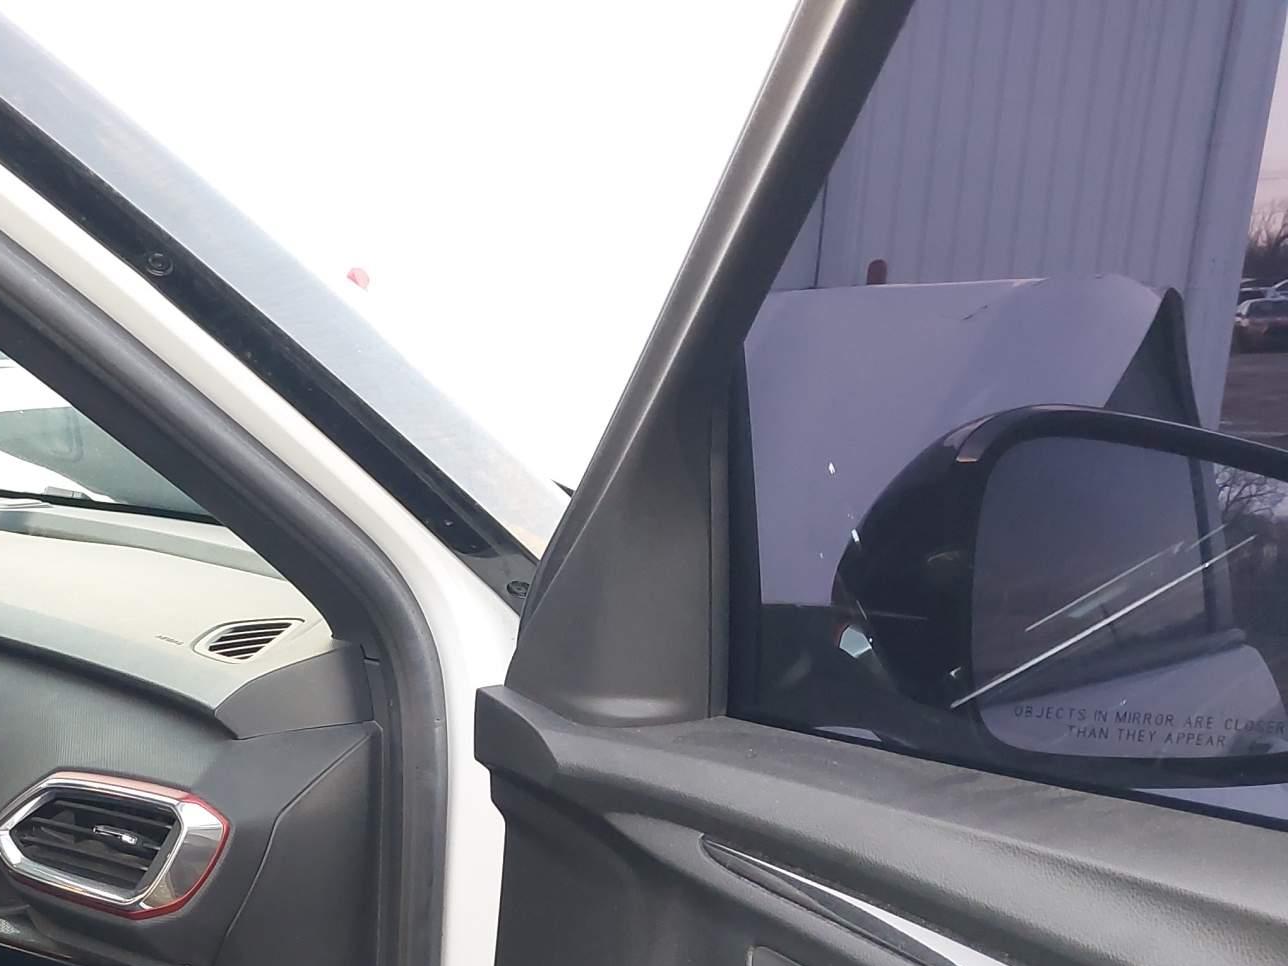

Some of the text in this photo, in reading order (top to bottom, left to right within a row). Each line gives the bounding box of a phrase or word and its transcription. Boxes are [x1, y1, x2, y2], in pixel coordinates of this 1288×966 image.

[1014, 704, 1285, 734] OBJECTS IN MIRROR ARE CLOSER
[1068, 725, 1226, 747] THAN THEY APPEAR
